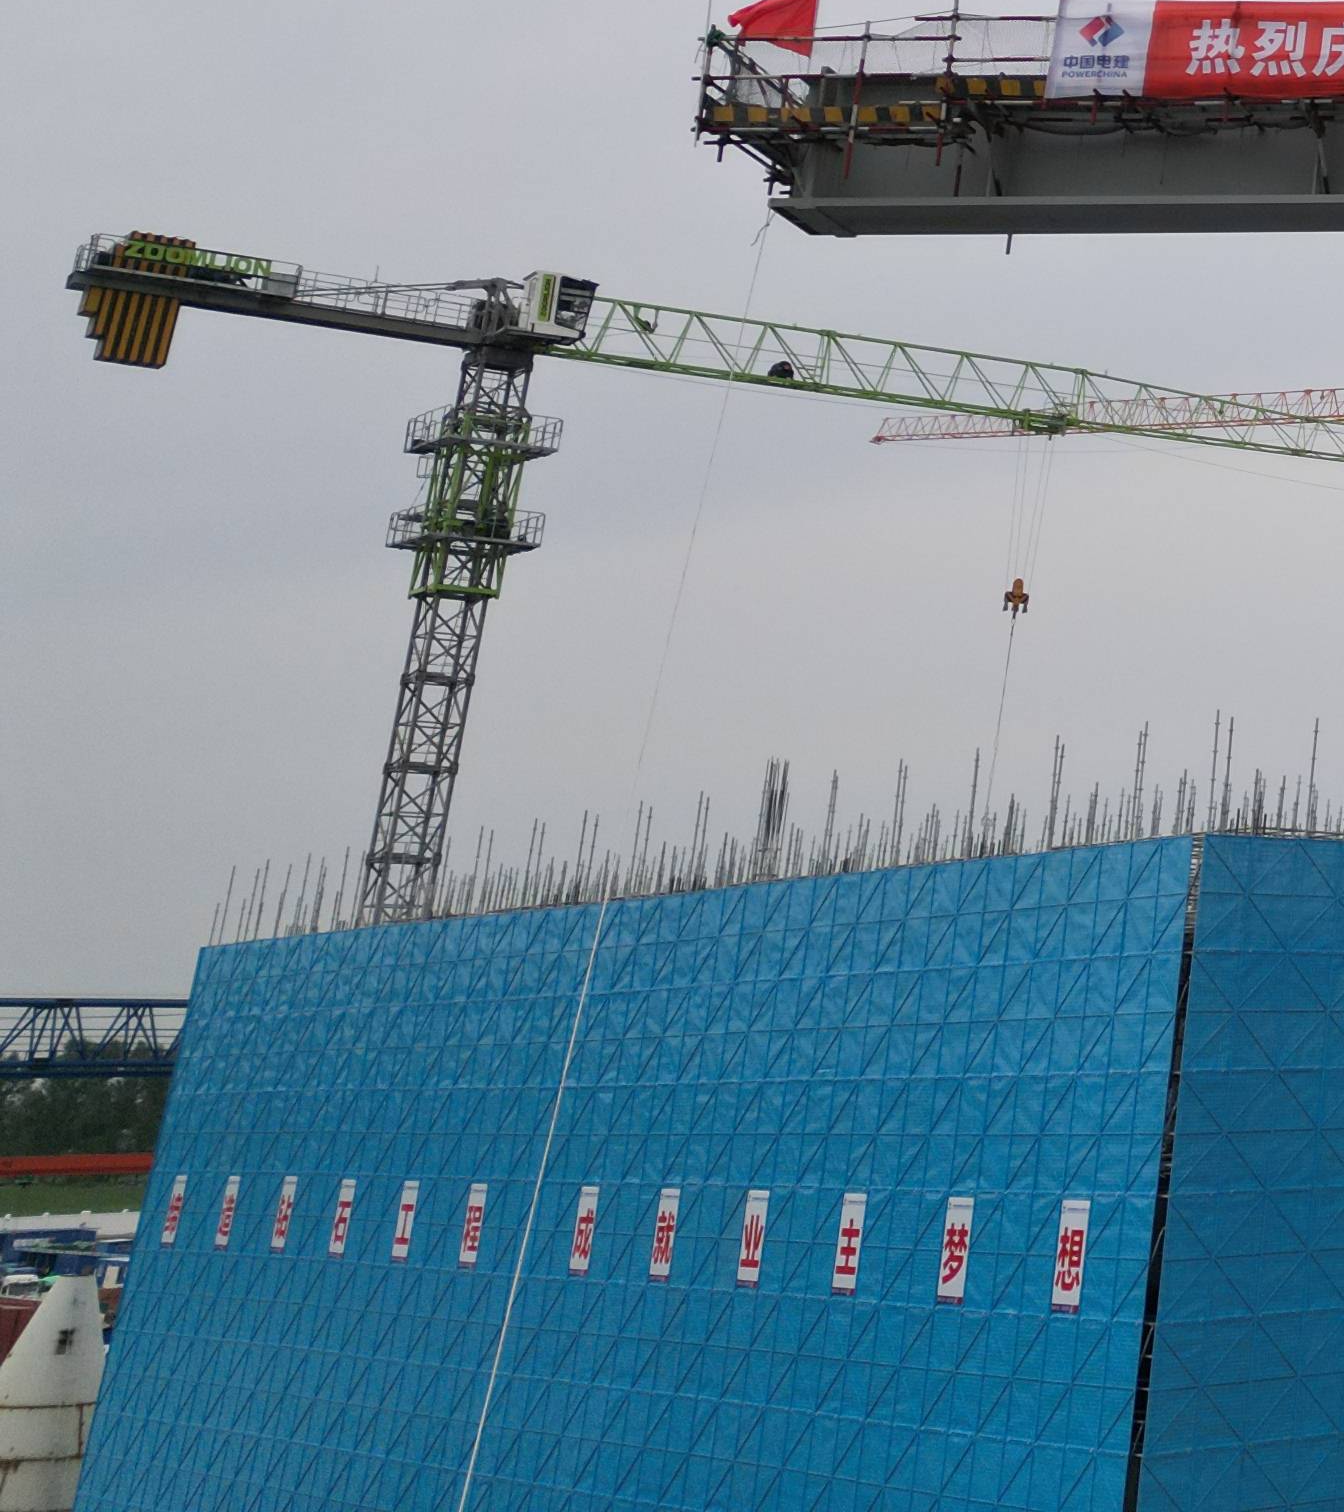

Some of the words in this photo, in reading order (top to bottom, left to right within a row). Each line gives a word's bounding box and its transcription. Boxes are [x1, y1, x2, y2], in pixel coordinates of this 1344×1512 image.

[1063, 55, 1130, 69] 中国电建
[1061, 70, 1128, 78] POWERCHINA
[125, 241, 272, 276] ZOOMLION
